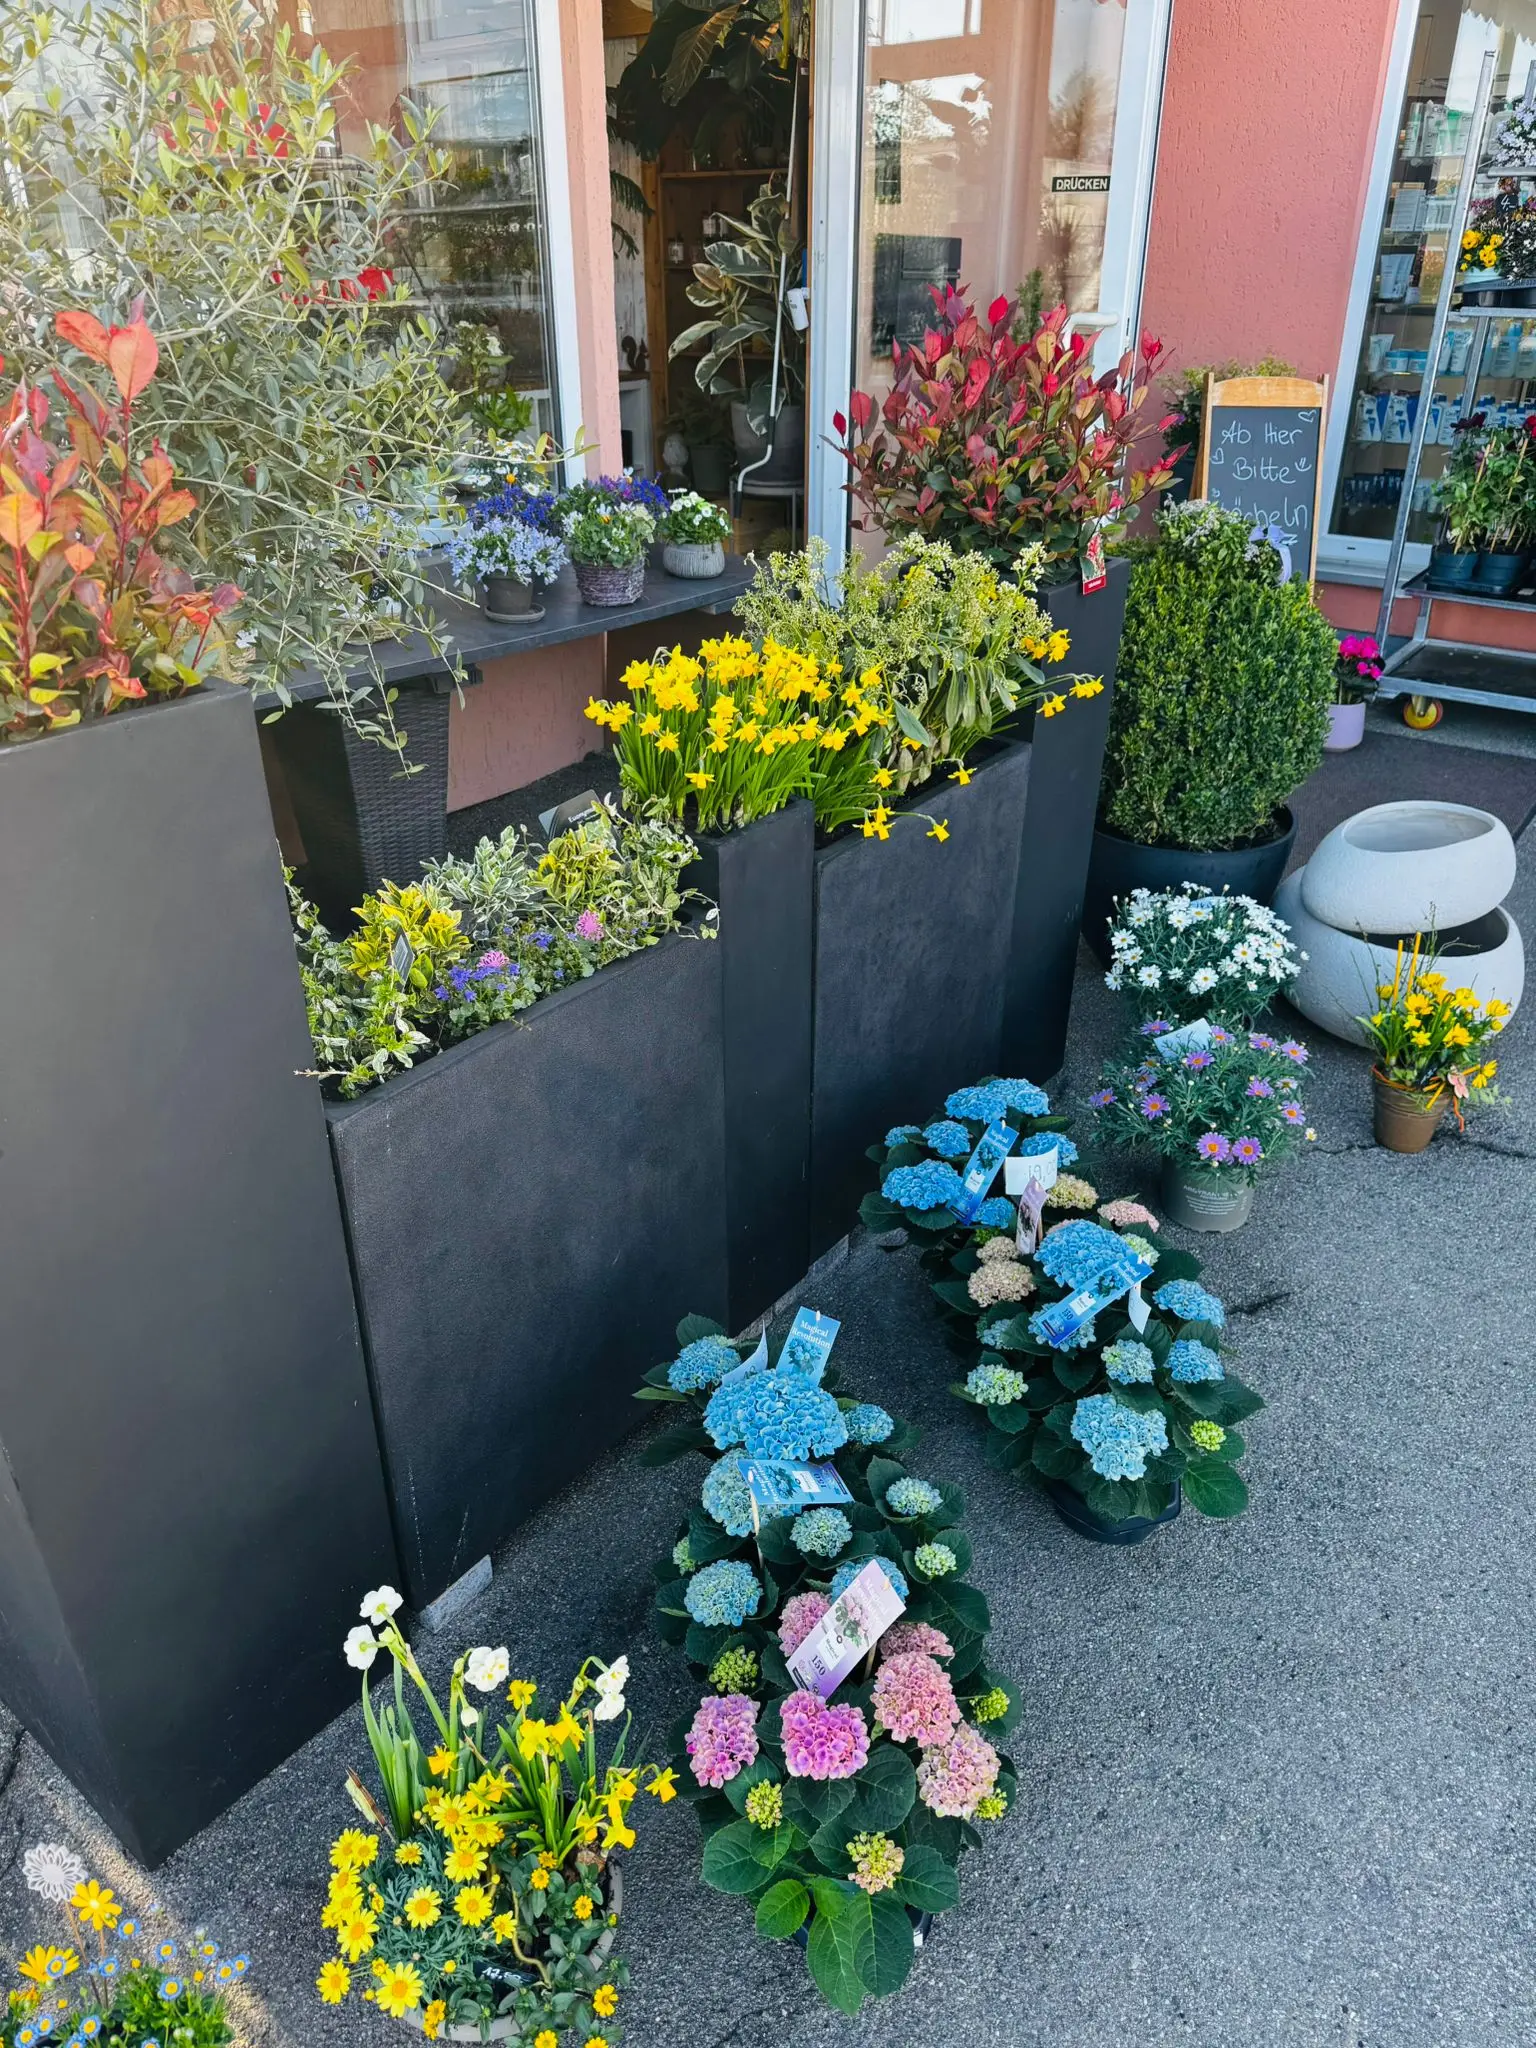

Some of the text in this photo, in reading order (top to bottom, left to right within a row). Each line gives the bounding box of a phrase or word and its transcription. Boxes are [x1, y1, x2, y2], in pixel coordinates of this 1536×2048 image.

[1056, 177, 1108, 190] DRÜCKEN
[1221, 420, 1303, 445] Ab Hier
[1232, 456, 1296, 484] Bitte
[791, 1328, 831, 1349] Revolution
[800, 1320, 829, 1338] Magical
[811, 1655, 826, 1676] 150
